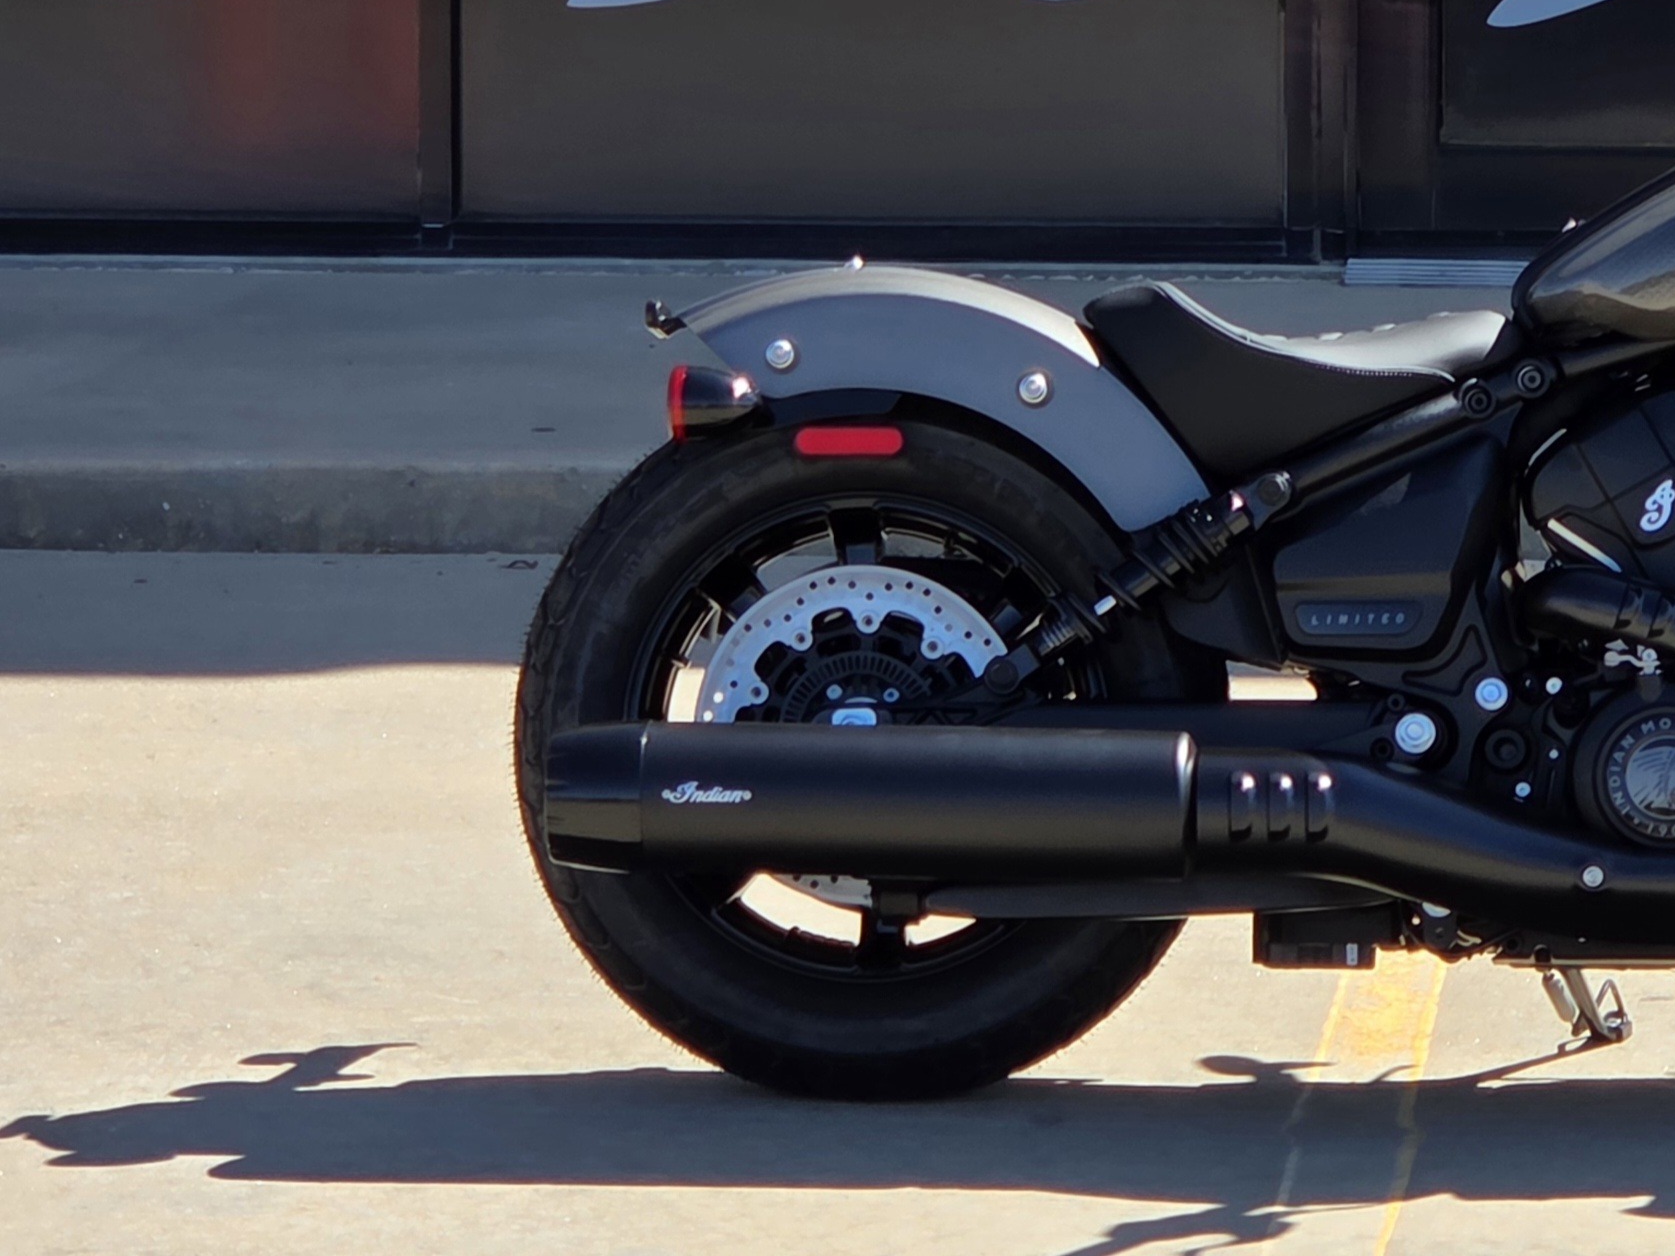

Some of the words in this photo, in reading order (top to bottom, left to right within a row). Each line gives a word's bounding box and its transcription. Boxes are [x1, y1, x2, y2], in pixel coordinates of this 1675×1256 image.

[1310, 612, 1406, 626] LIMITED
[1608, 734, 1636, 816] INDIAN
[669, 780, 742, 804] Indian
